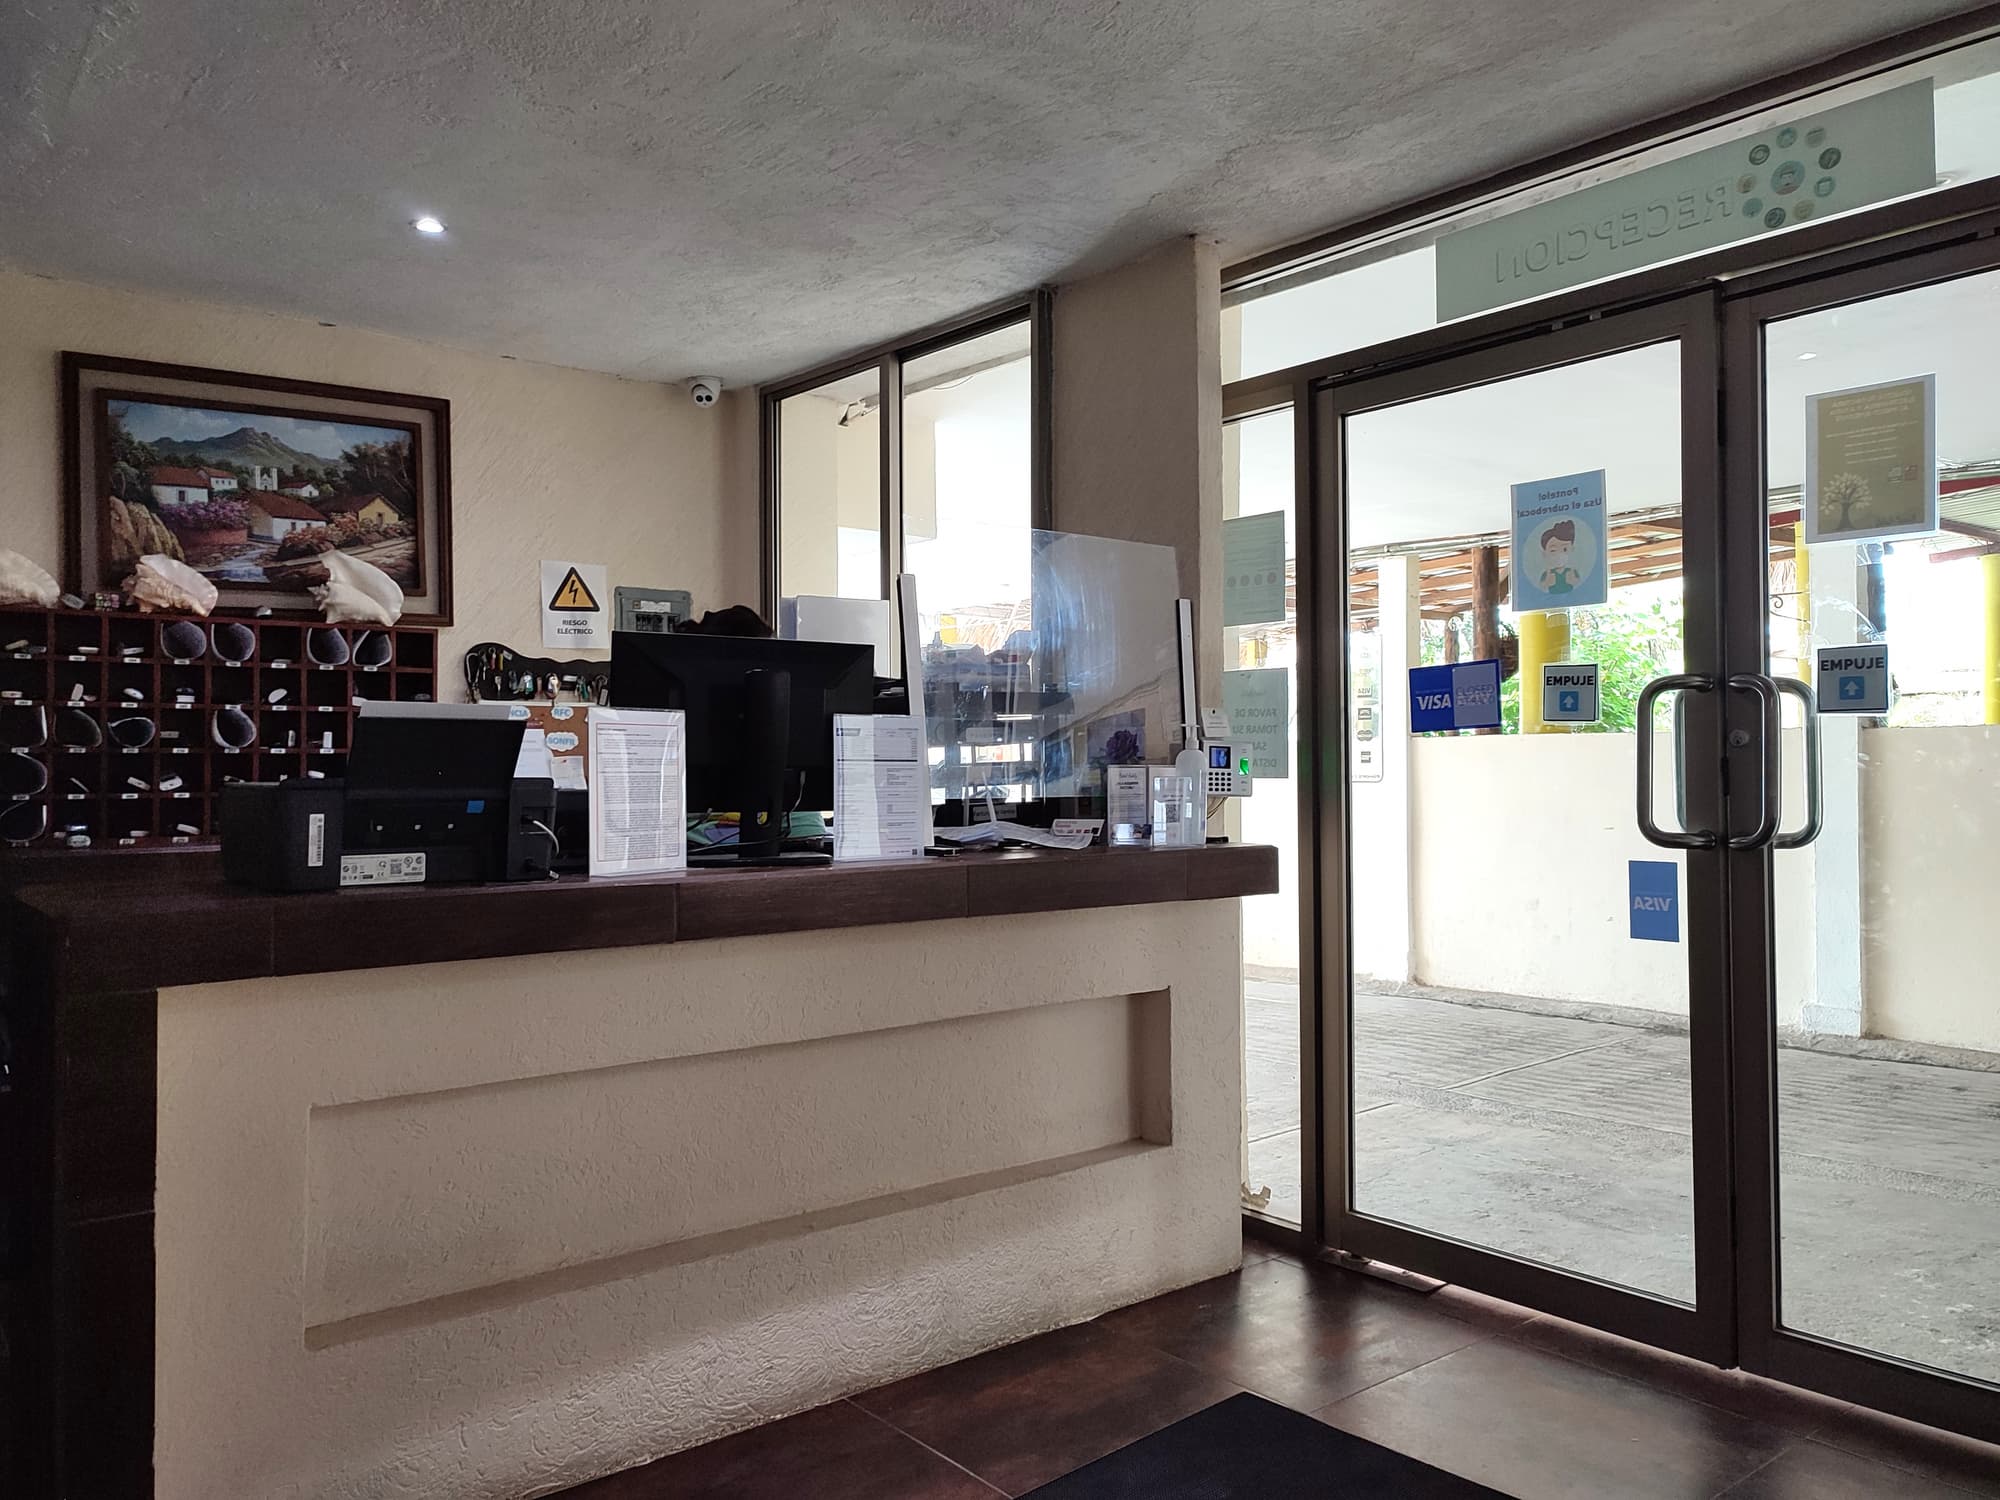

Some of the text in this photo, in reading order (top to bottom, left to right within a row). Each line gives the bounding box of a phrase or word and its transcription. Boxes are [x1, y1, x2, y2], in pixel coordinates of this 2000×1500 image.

[557, 627, 593, 635] ELÉCTRICO
[1820, 656, 1885, 672] EMPUJE
[1545, 675, 1595, 687] EMPUJE
[1415, 693, 1452, 711] VISA
[553, 707, 572, 717] RFC
